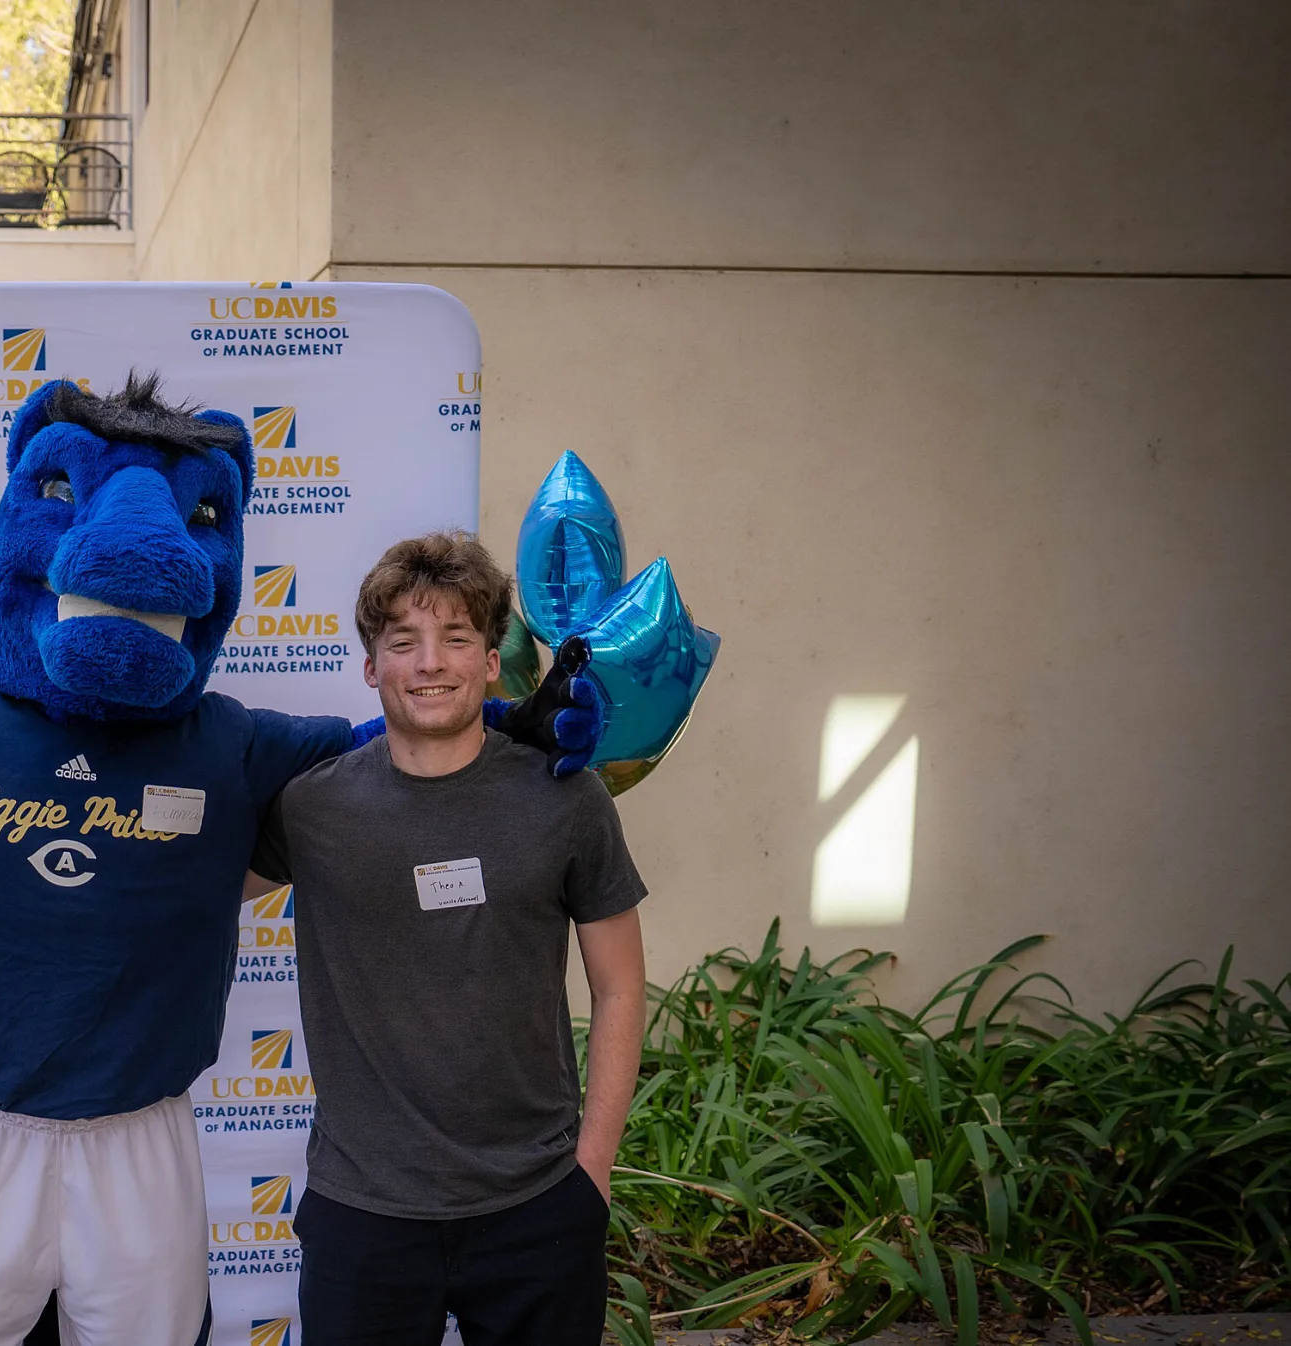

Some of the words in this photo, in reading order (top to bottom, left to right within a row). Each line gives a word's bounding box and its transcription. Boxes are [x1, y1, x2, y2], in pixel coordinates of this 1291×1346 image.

[210, 296, 338, 319] UCDAVIS
[191, 329, 277, 340] GRADUATE
[285, 327, 350, 339] SCHOOL
[204, 348, 218, 356] OF
[223, 344, 344, 356] MANAGEMENT
[451, 423, 464, 431] OF
[257, 456, 340, 478] DAVIS
[287, 486, 352, 498] SCHOOL
[227, 614, 339, 637] CDAVIS
[287, 645, 350, 657] SCHOOL
[226, 661, 344, 673] MANAGEMENT
[55, 768, 97, 782] adidas
[430, 881, 454, 893] Theo
[193, 1106, 276, 1119] GRADUATE
[205, 1124, 219, 1132] OF
[213, 1220, 298, 1243] UCDA
[208, 1249, 276, 1263] RADUATE
